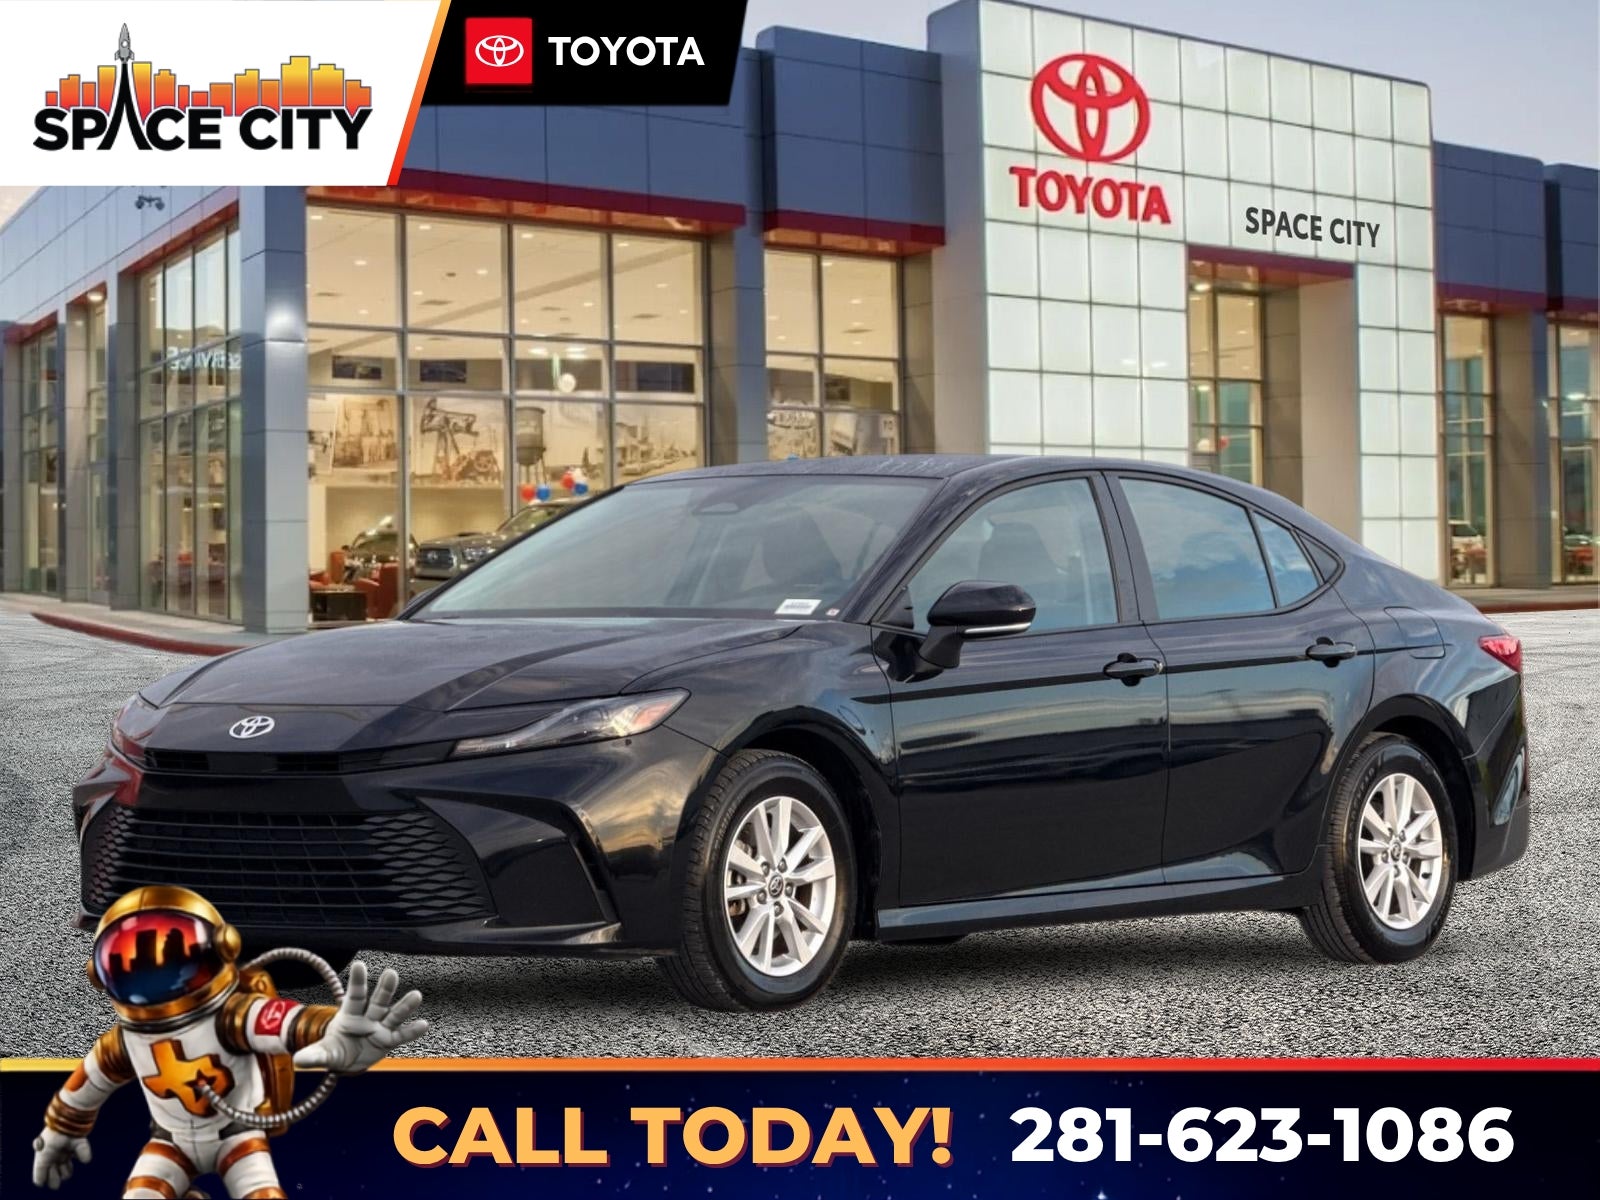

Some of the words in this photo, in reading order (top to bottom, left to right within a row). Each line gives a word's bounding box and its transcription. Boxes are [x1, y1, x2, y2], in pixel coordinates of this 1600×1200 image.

[1010, 165, 1171, 224] TOYOTA
[1245, 206, 1323, 242] SPACE
[1329, 218, 1380, 248] CITY
